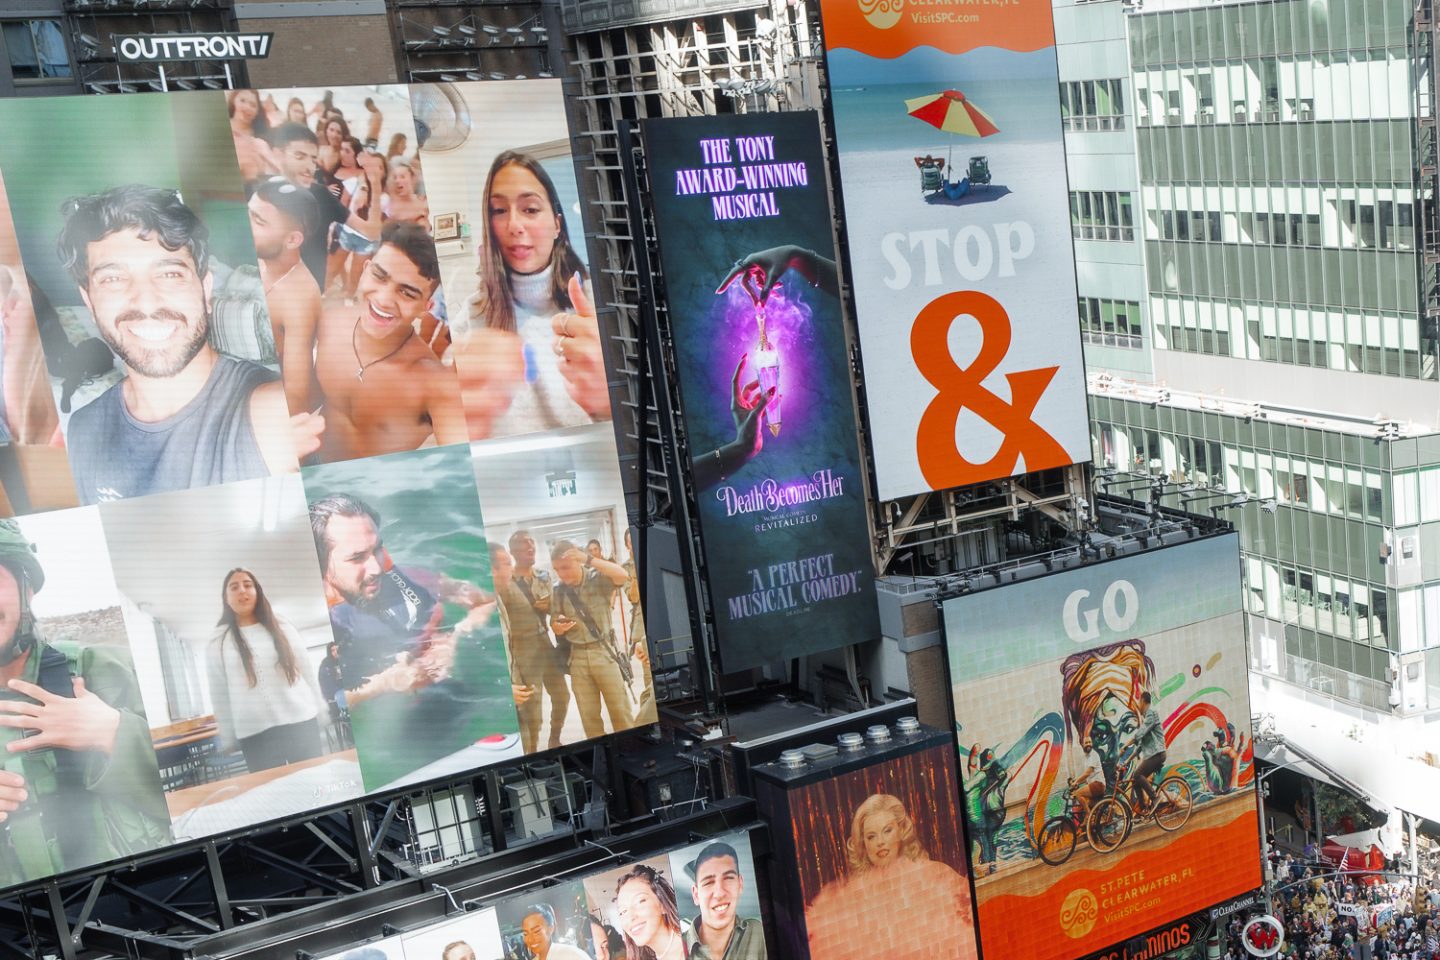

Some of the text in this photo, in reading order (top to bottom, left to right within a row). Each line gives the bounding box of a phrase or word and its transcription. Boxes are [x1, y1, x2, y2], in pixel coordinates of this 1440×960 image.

[911, 12, 980, 24] VisitSPC.com
[700, 136, 774, 164] THE TONY
[676, 162, 808, 195] AWARD-WINNING
[712, 192, 780, 221] MUSICAL
[881, 220, 1036, 290] STOP
[910, 290, 1073, 491] &
[716, 469, 844, 517] Death Becomes Her
[754, 514, 818, 533] REVITALIZED
[769, 553, 834, 588] PERFECT
[728, 586, 797, 620] MUSICAL
[1063, 579, 1139, 643] GO
[1104, 897, 1161, 923] VisitSPC.com
[1249, 928, 1277, 950] W
